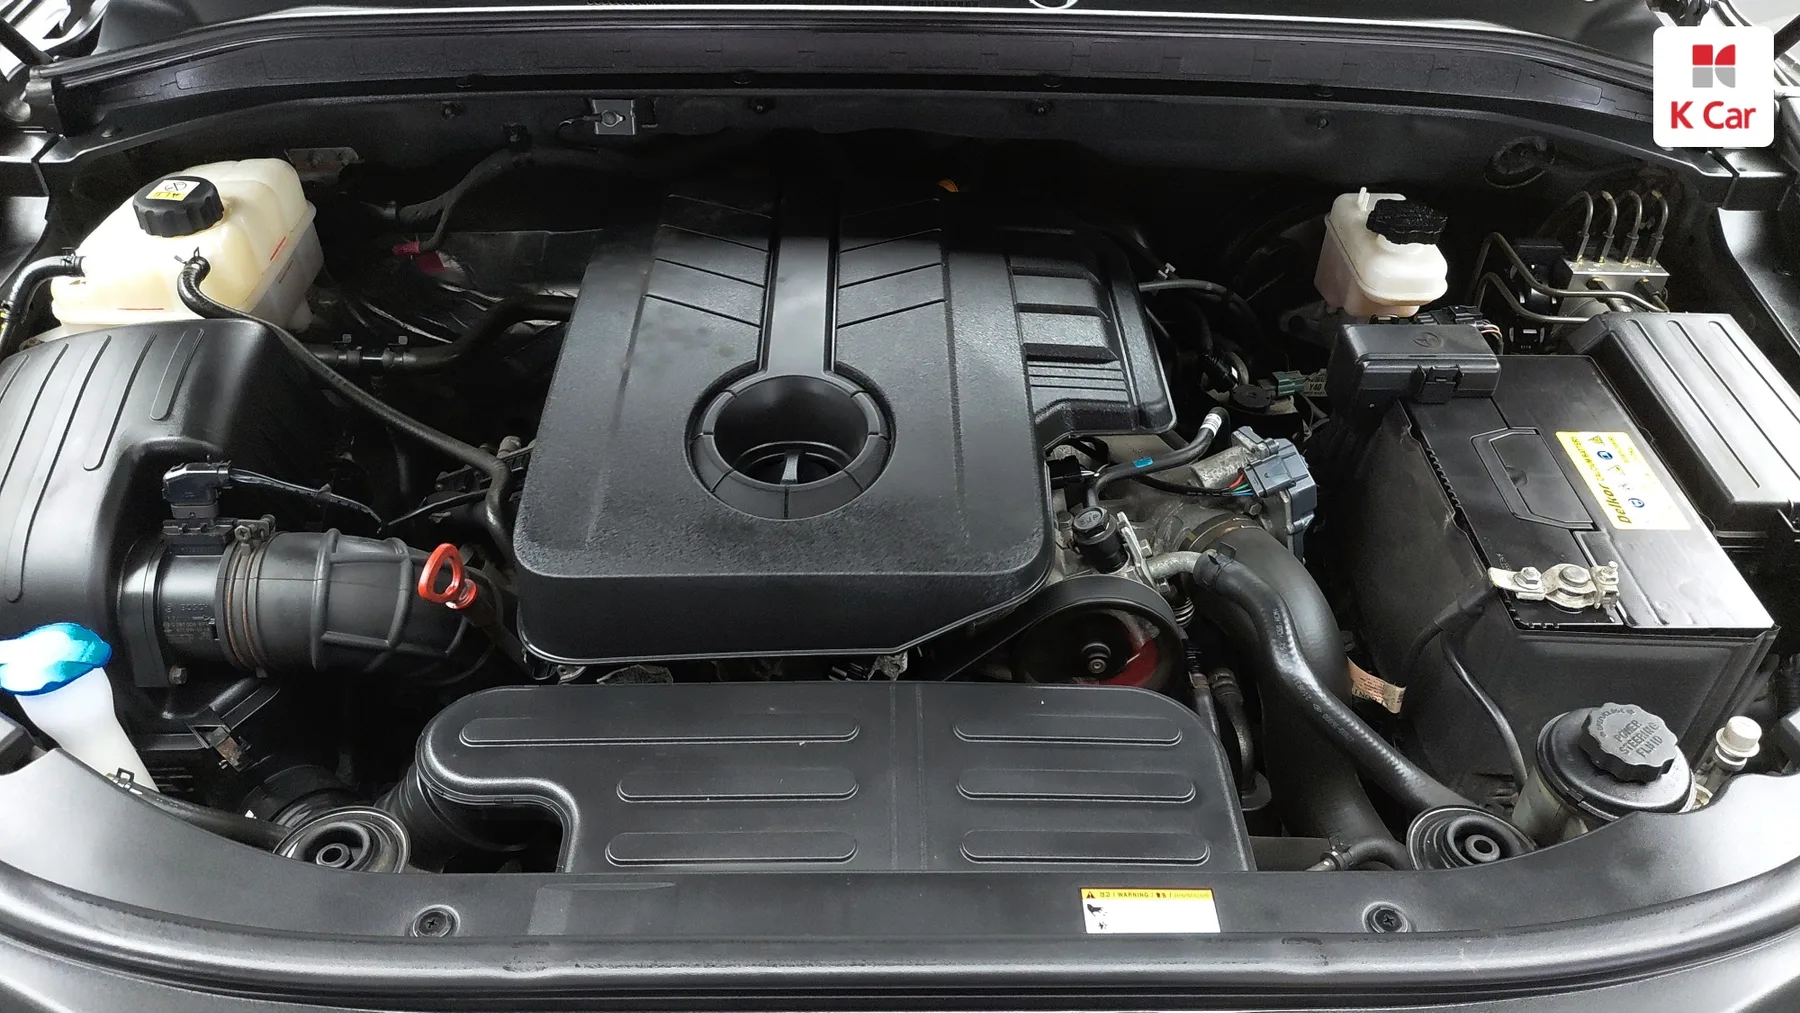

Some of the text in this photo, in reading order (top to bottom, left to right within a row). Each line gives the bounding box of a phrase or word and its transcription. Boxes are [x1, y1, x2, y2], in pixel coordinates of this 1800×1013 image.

[1599, 482, 1632, 524] Delkor
[1614, 720, 1642, 742] POWER
[1619, 722, 1659, 755] STEERING
[1636, 735, 1662, 757] FLUID
